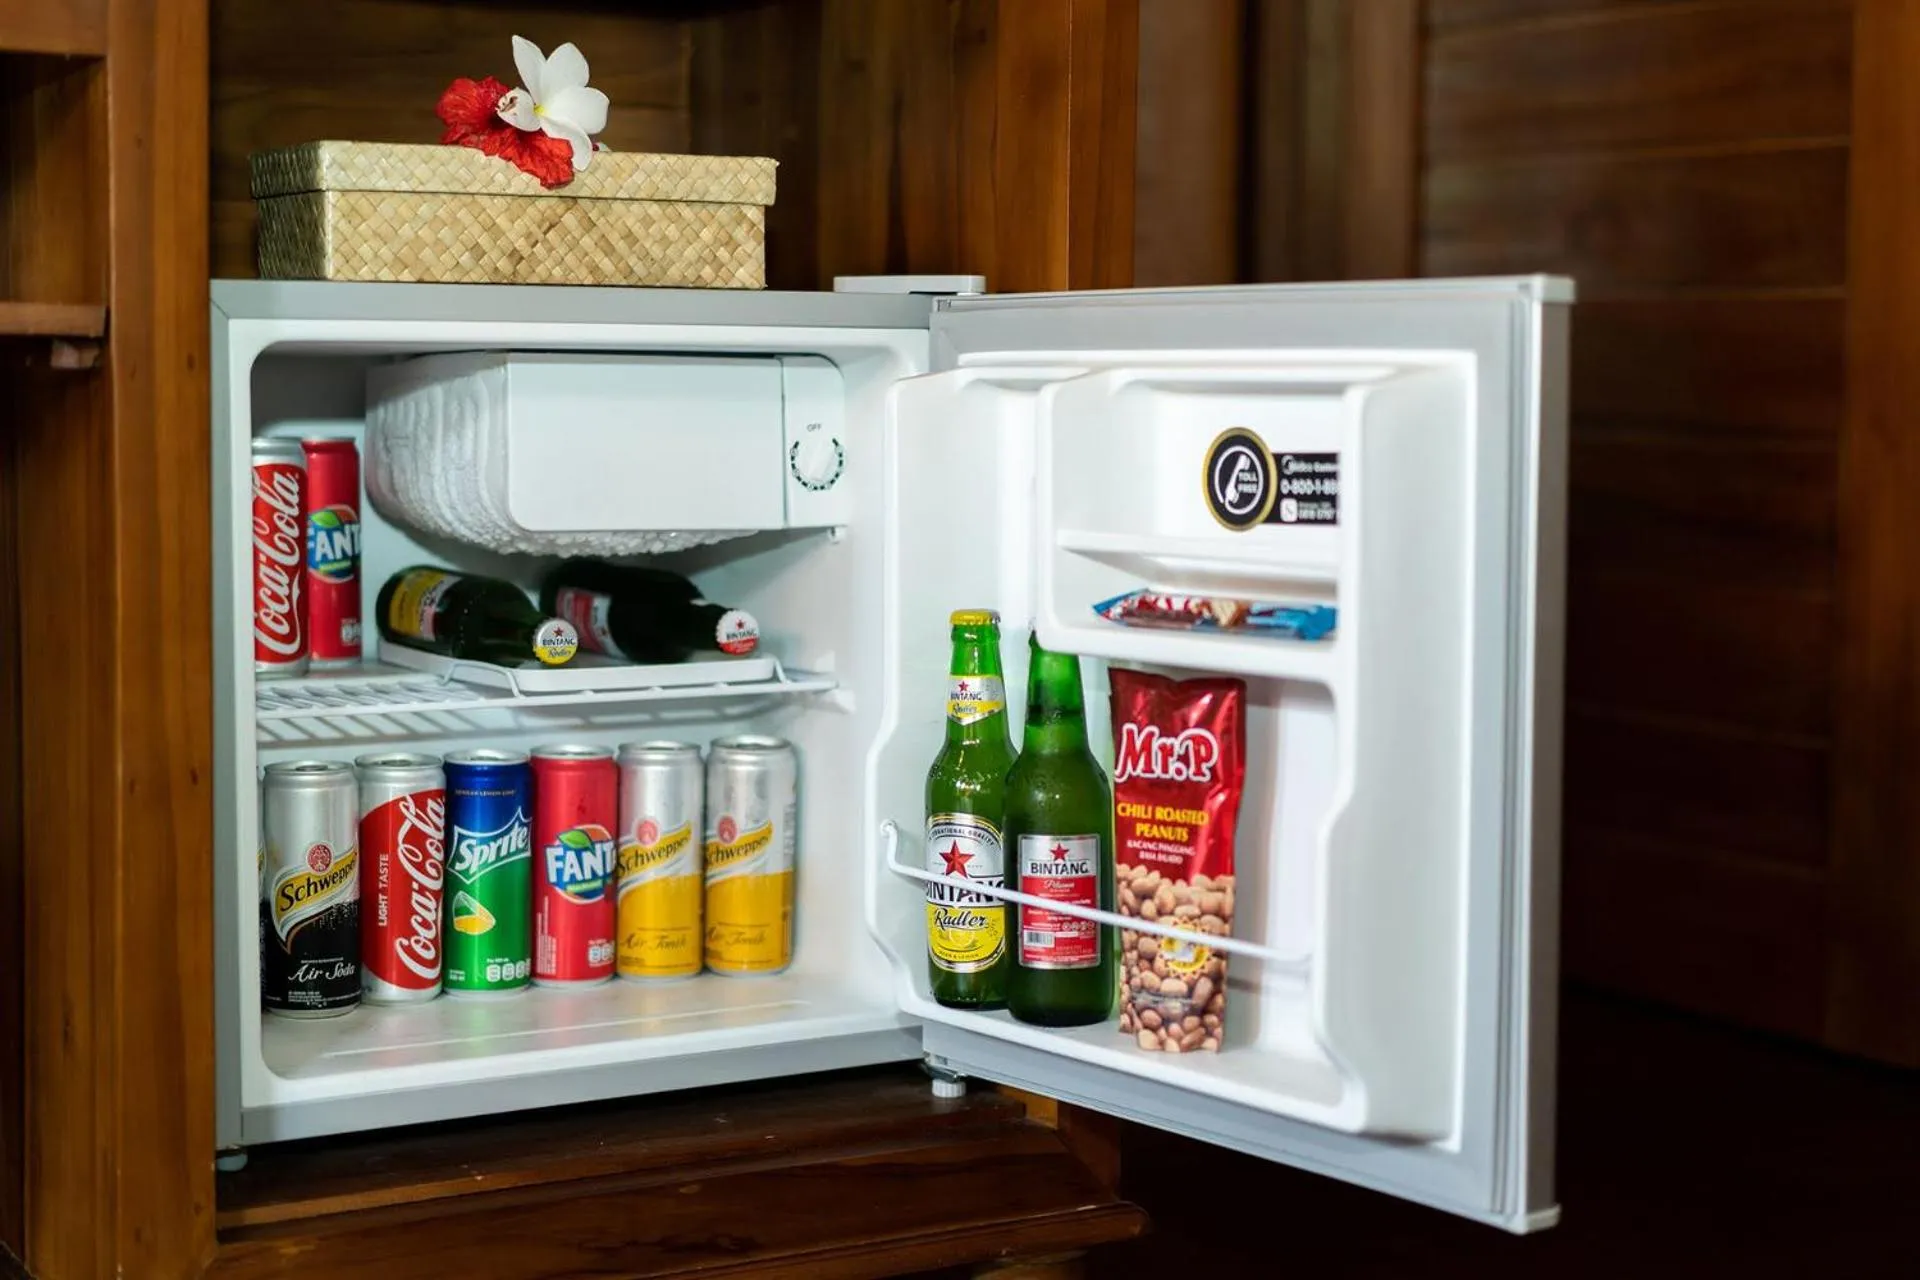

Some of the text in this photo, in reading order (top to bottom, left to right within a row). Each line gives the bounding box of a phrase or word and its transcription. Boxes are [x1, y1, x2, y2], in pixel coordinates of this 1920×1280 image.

[1115, 722, 1219, 783] Mr.P
[1116, 802, 1209, 826] CHILI ROASTED
[1135, 823, 1189, 843] PEANUTS
[454, 821, 528, 875] Sprite
[545, 841, 617, 883] FANT
[1030, 862, 1089, 875] BINTANG
[378, 853, 389, 926] LIGHT TASTE
[934, 907, 988, 931] Radler
[287, 963, 324, 983] Air
